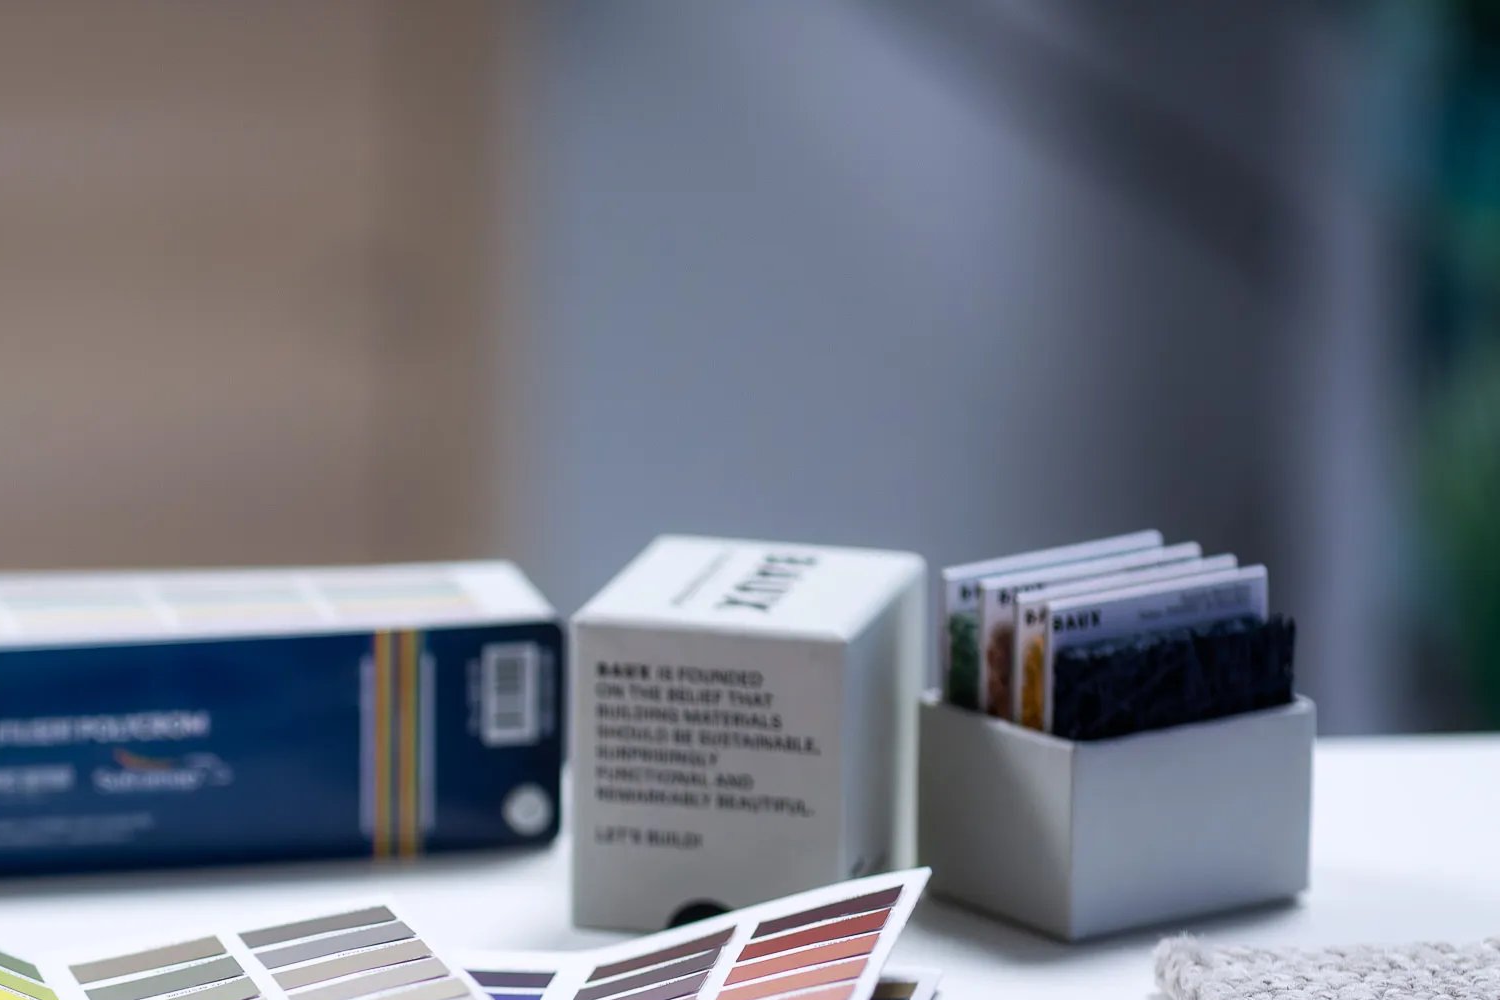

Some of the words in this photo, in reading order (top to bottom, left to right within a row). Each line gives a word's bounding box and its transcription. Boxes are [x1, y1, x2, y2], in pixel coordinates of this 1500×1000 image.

[1053, 609, 1101, 633] BAUX
[677, 666, 764, 688] FOUNDED
[629, 684, 661, 701] THE
[666, 686, 721, 704] BELIEF
[728, 689, 774, 708] THAT
[595, 703, 679, 723] BUILDING
[683, 708, 783, 730] MATERIALS
[715, 773, 754, 791] AND
